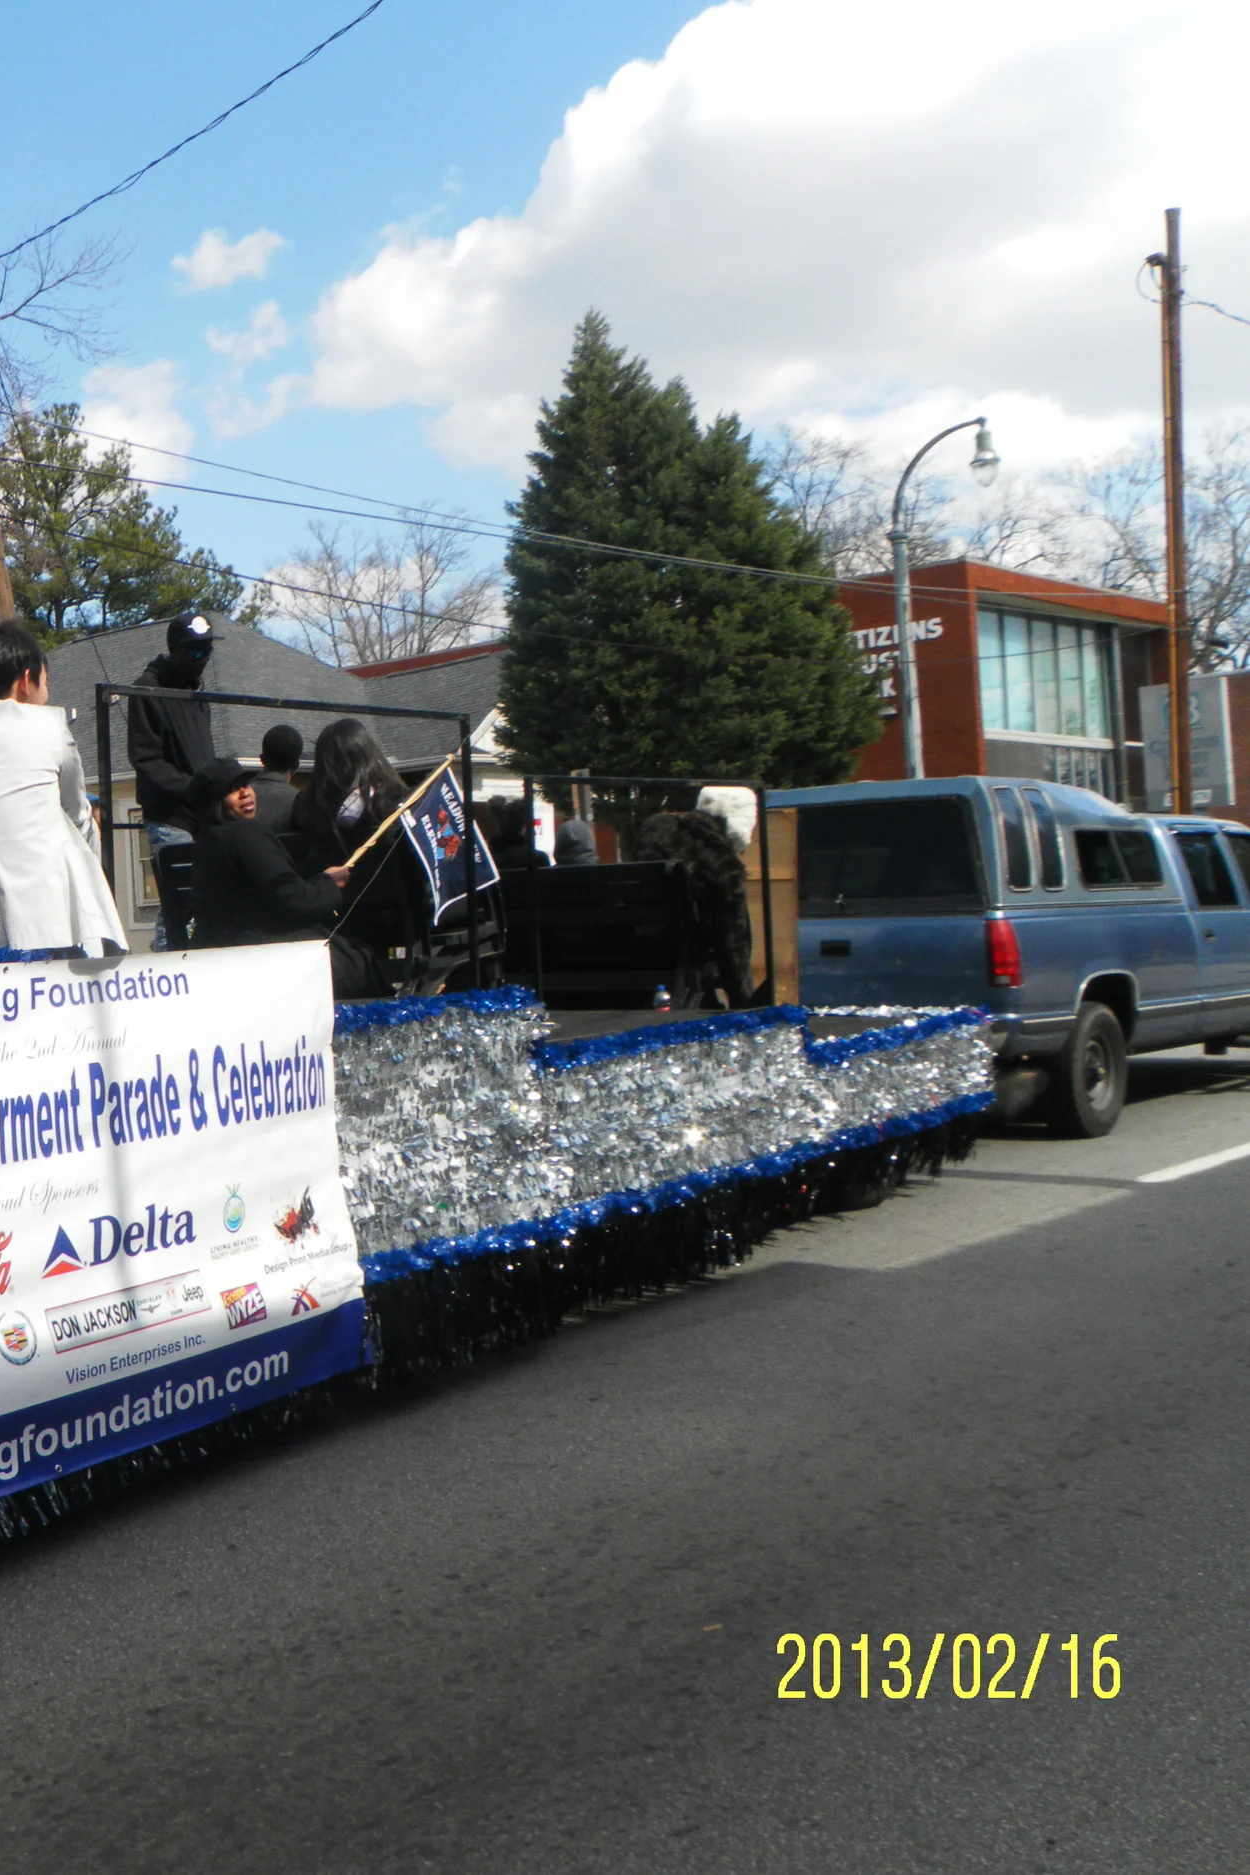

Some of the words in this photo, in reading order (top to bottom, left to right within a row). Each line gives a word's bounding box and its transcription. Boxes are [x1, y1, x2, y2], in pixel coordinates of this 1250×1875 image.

[846, 616, 944, 650] TIZNS
[30, 968, 190, 1010] Foundation
[24, 1035, 57, 1059] 2nd
[62, 1026, 127, 1055] Annual
[89, 1054, 181, 1148] Parade
[188, 1048, 208, 1131] &
[212, 1035, 326, 1127] Celebration
[30, 1177, 99, 1214] Sponsors
[89, 1203, 197, 1268] Delta
[210, 1242, 231, 1254] LIVING
[233, 1236, 258, 1247] HEALTHY
[264, 1261, 289, 1275] Design
[289, 1254, 307, 1268] Print
[307, 1248, 329, 1261] Media
[182, 1284, 204, 1302] Jeep
[226, 1287, 266, 1328] WYZE
[52, 1317, 81, 1342] DON
[83, 1299, 138, 1332] JACKSON
[66, 1361, 107, 1385] Vision
[110, 1341, 181, 1374] Enterprises
[183, 1332, 206, 1353] Inc.
